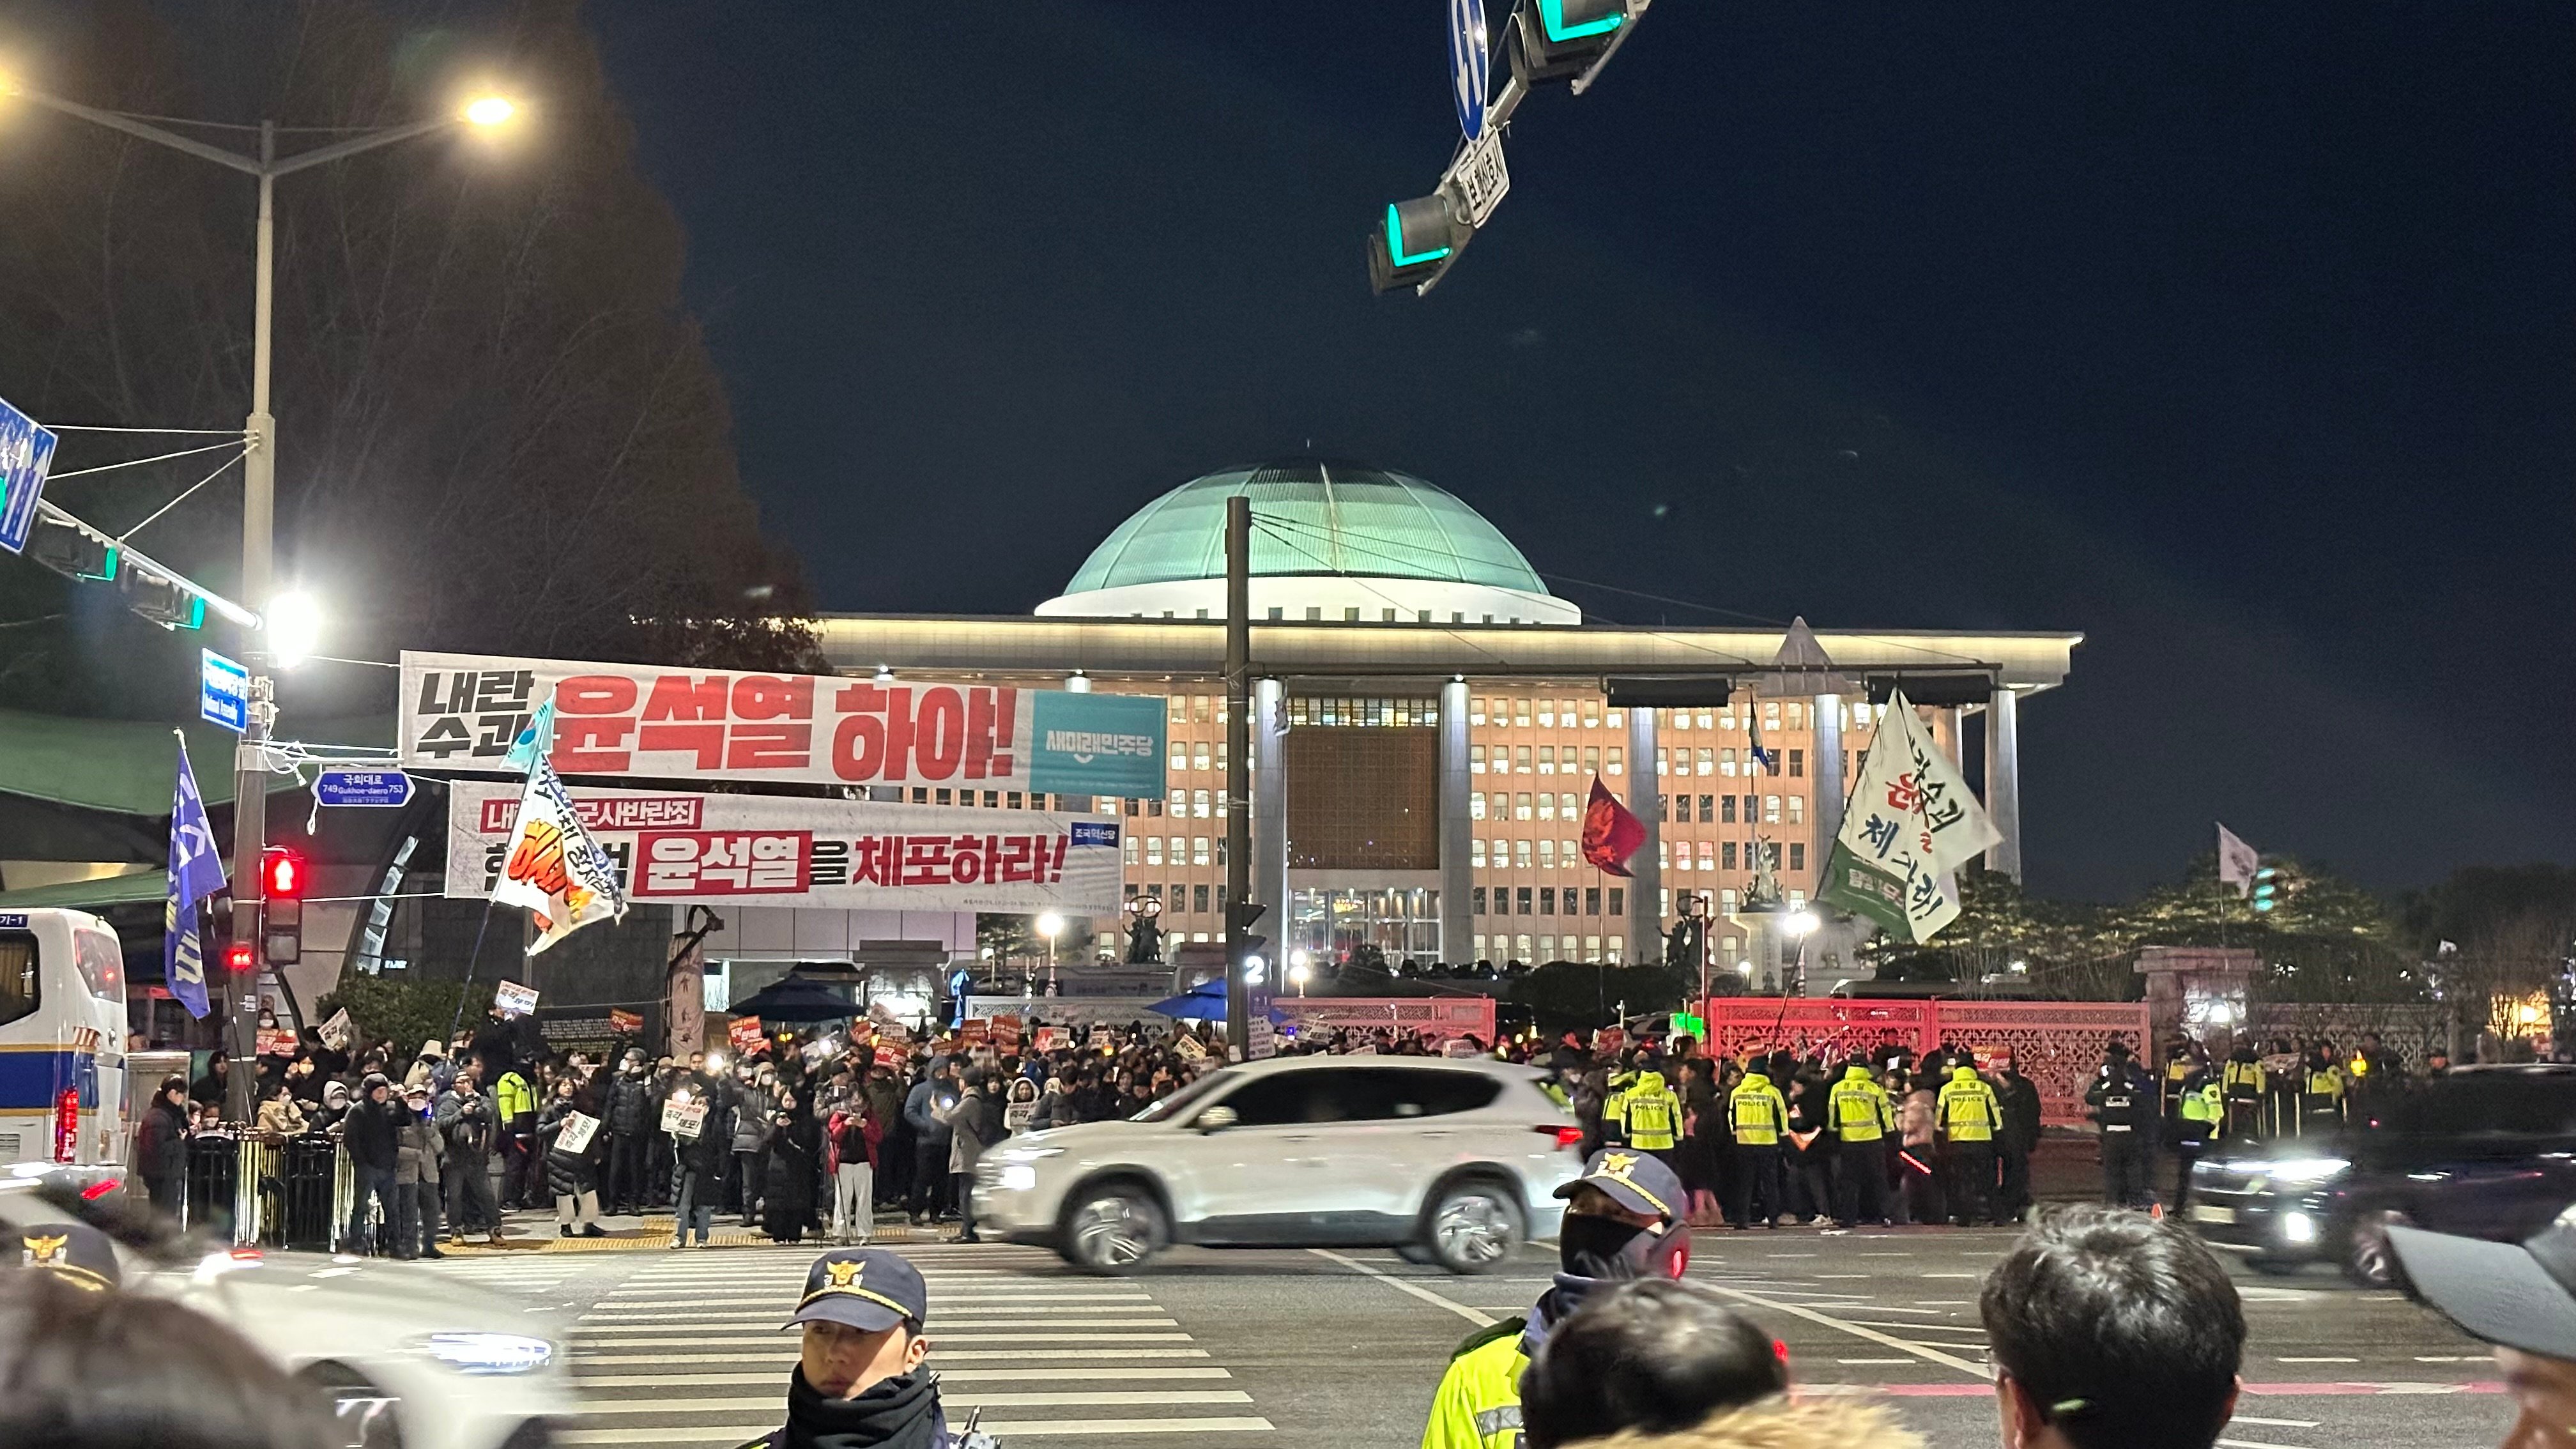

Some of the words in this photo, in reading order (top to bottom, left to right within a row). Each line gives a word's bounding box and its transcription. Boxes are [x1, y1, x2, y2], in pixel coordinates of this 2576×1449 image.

[418, 670, 535, 715] 내란
[416, 714, 533, 759] 수괴
[552, 675, 814, 772] 윤석열
[832, 683, 1016, 782] 하야!
[1046, 730, 1154, 758] 새미래민주당
[323, 785, 337, 793] 749
[338, 786, 388, 795] Gukhoe-daero
[388, 785, 404, 793] 753
[343, 774, 383, 785] 국회대로
[575, 800, 696, 828] 군사반란죄
[1075, 828, 1117, 841] 조국혁신당
[852, 835, 1068, 887] 체포하라!
[1245, 955, 1264, 983] 2
